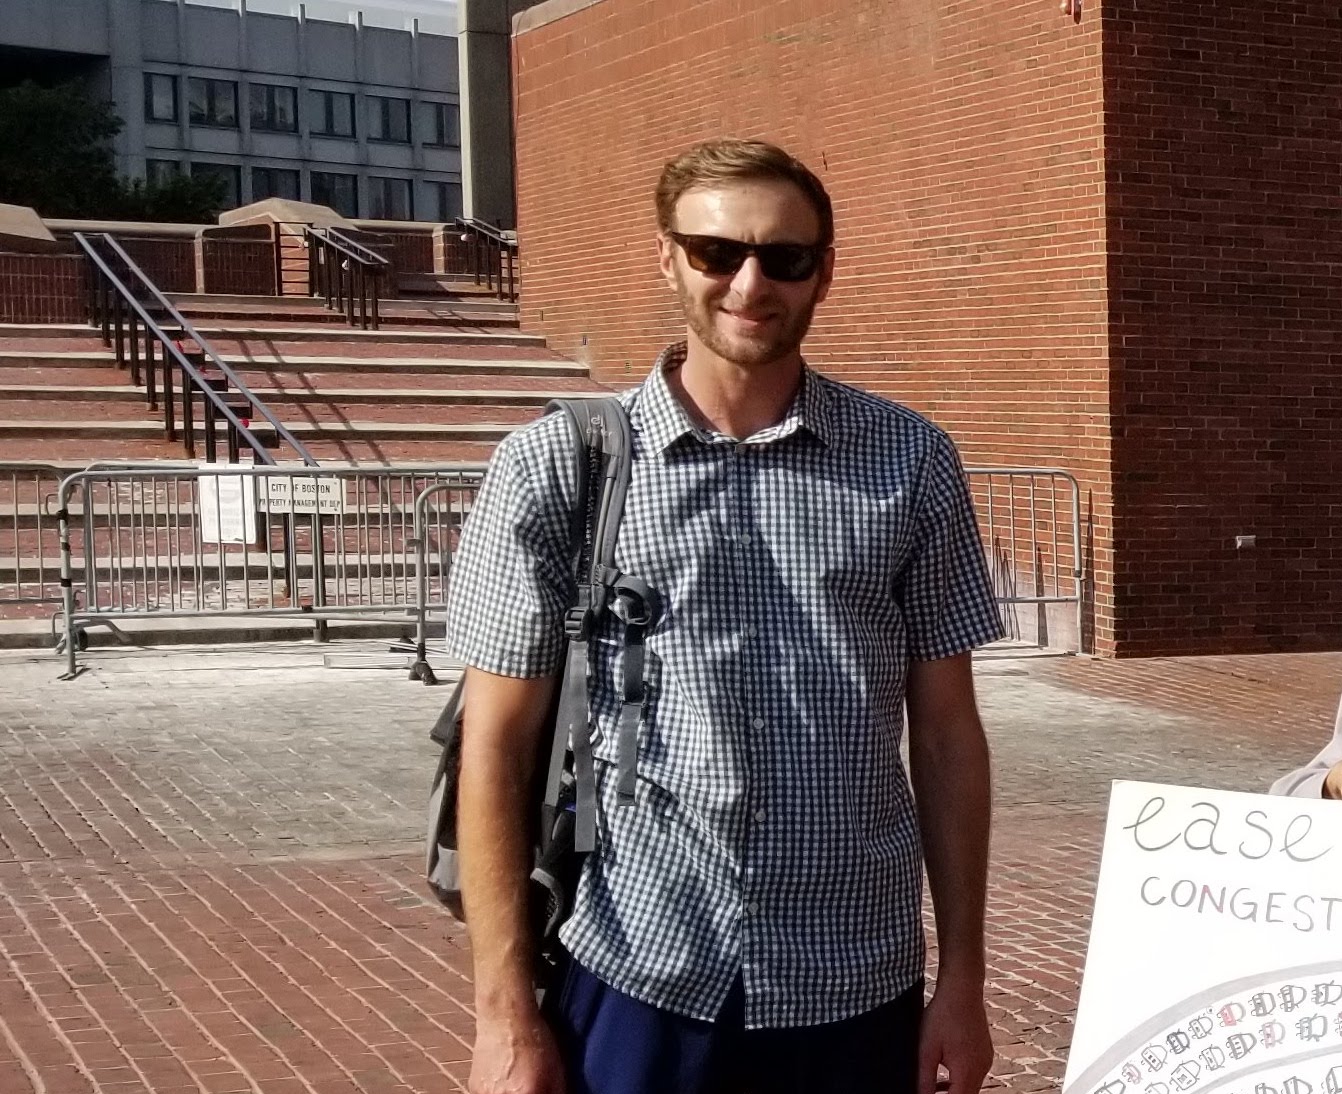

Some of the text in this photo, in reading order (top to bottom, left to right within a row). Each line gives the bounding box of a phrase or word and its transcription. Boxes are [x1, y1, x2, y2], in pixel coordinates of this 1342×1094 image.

[271, 484, 286, 492] CITY
[302, 484, 331, 493] BOSON
[258, 498, 341, 508] PRPERTY MANAGEMNT DEP
[1122, 796, 1334, 862] ease
